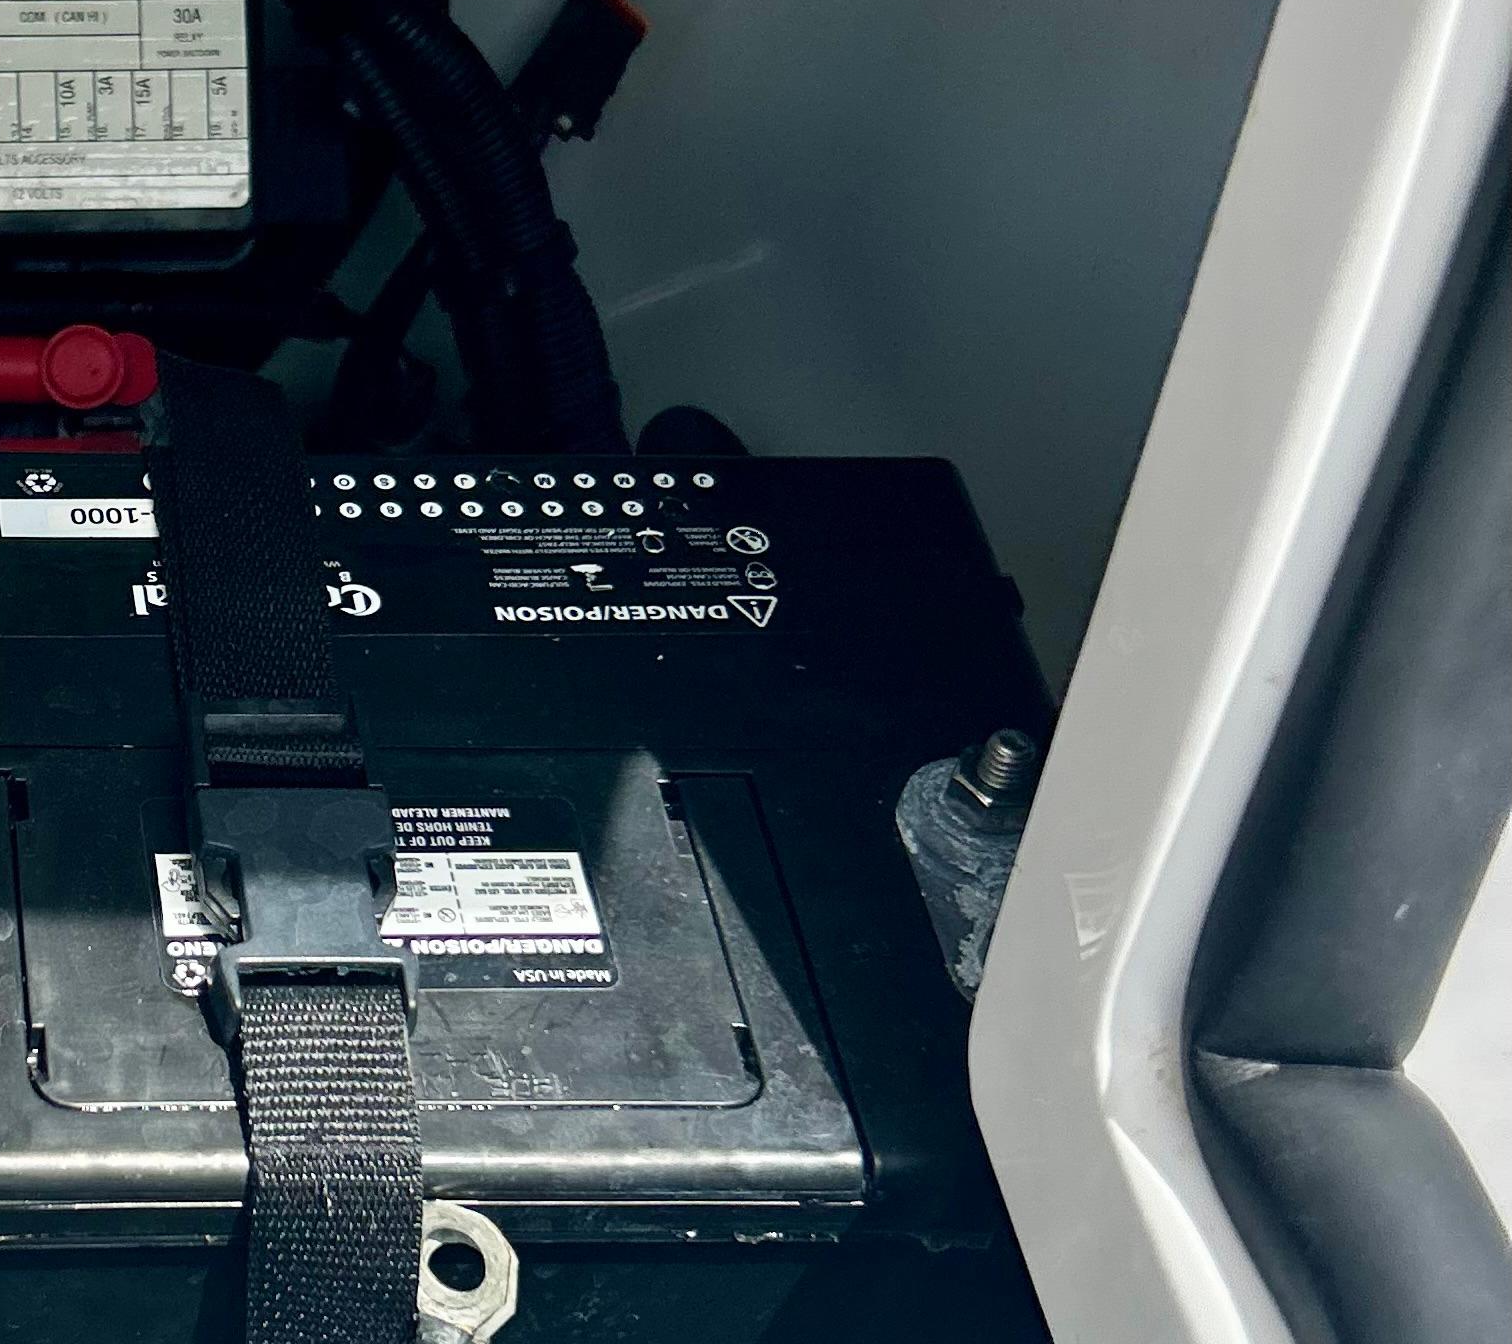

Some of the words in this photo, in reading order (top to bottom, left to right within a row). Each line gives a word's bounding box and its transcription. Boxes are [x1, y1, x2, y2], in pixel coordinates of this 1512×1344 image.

[173, 8, 202, 24] 30A
[59, 79, 76, 107] 10A
[97, 76, 114, 96] 3A
[136, 78, 152, 105] 15A
[211, 76, 228, 96] 5A
[493, 605, 729, 622] DANGER/POISON
[391, 808, 438, 819] ALEJAD
[440, 808, 512, 819] MANTENER
[396, 822, 413, 833] DE
[416, 822, 453, 833] HORS
[456, 822, 494, 833] TENIR
[409, 836, 427, 847] OF
[429, 836, 457, 847] OUT
[458, 836, 491, 847] KEEP
[410, 938, 604, 955] DANGER/POISON
[512, 969, 545, 983] USA
[567, 969, 612, 983] Made
